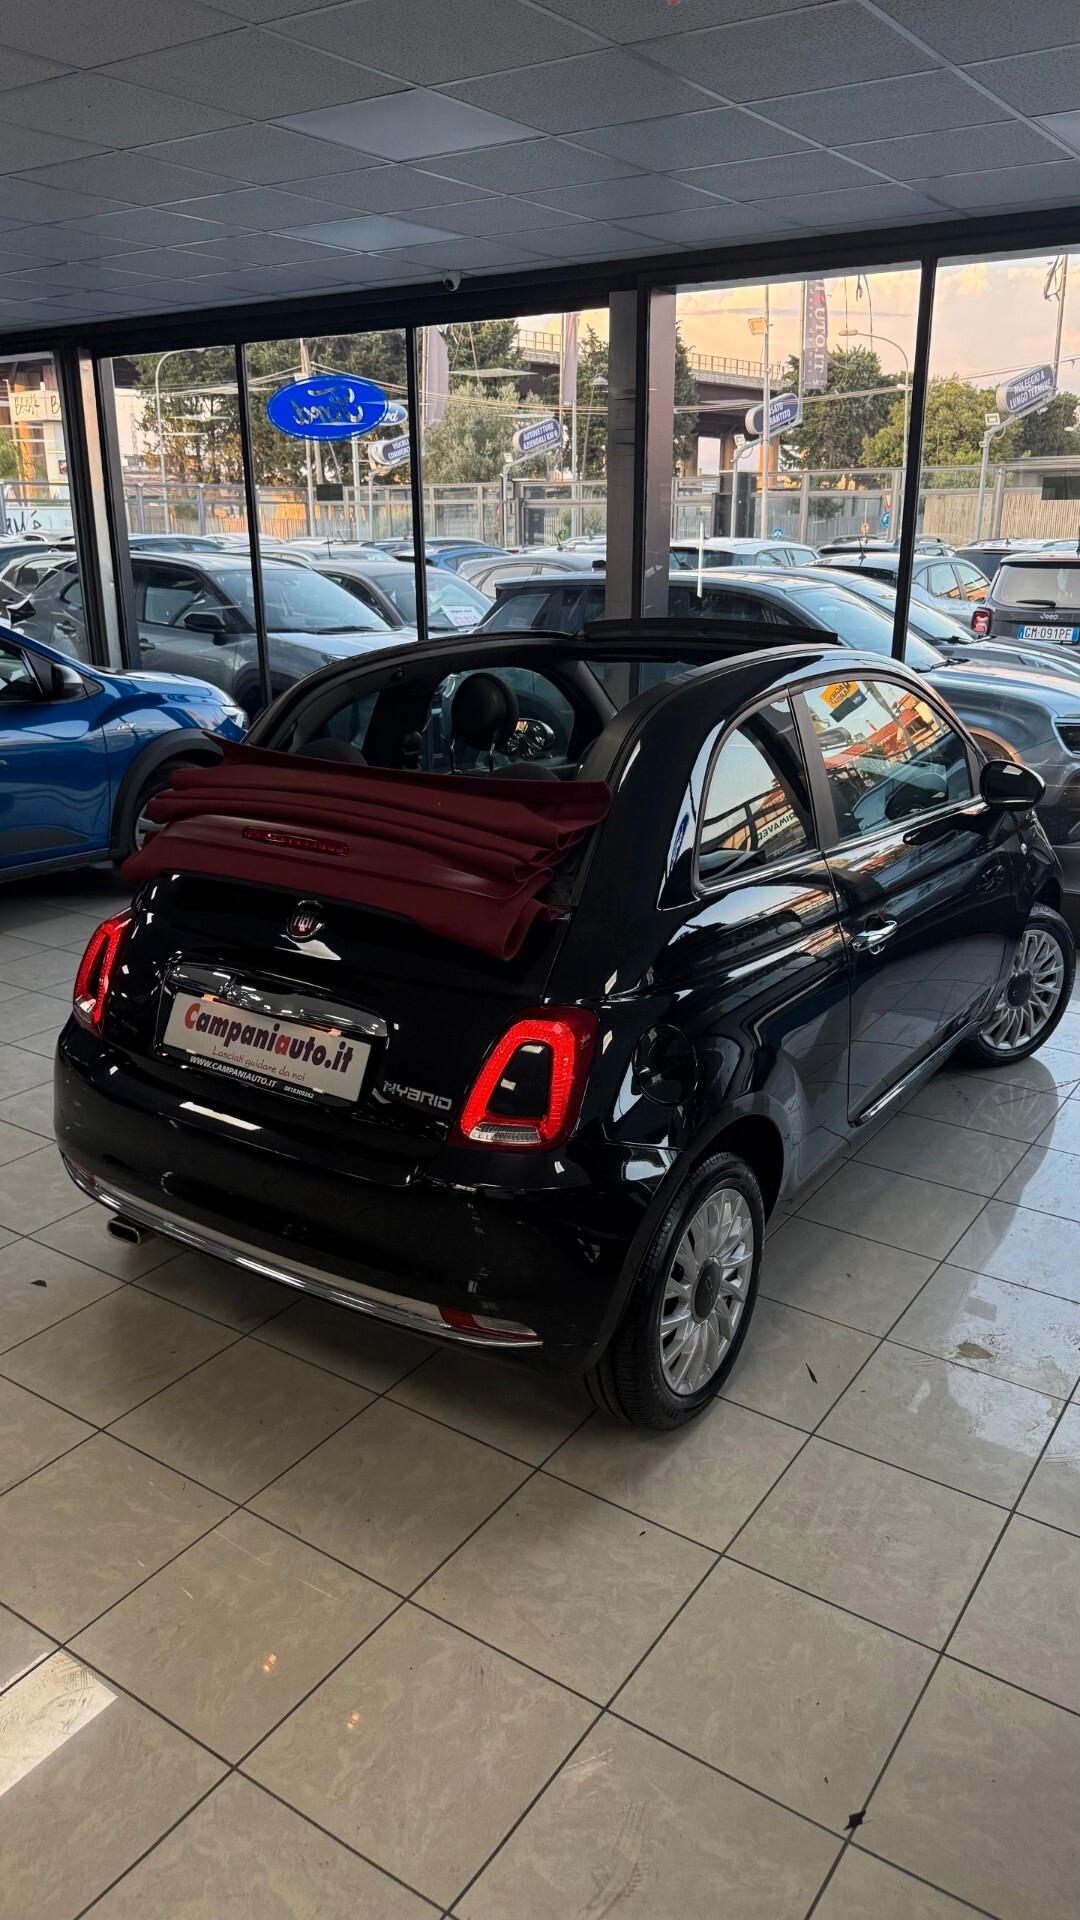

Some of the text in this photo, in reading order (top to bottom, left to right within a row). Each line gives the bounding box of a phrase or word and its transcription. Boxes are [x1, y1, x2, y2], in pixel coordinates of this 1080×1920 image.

[1010, 391, 1028, 410] LUNGO
[523, 422, 555, 441] AUTOVETTURE
[523, 433, 547, 450] AZIENDALI
[1040, 612, 1059, 621] Jeep
[184, 1002, 354, 1074] Campaniauto.it
[189, 1055, 278, 1088] WWW.CAMPANIAUTO.IT
[212, 1045, 306, 1082] Lasciati guidare da noi
[383, 1080, 452, 1111] HYBRID
